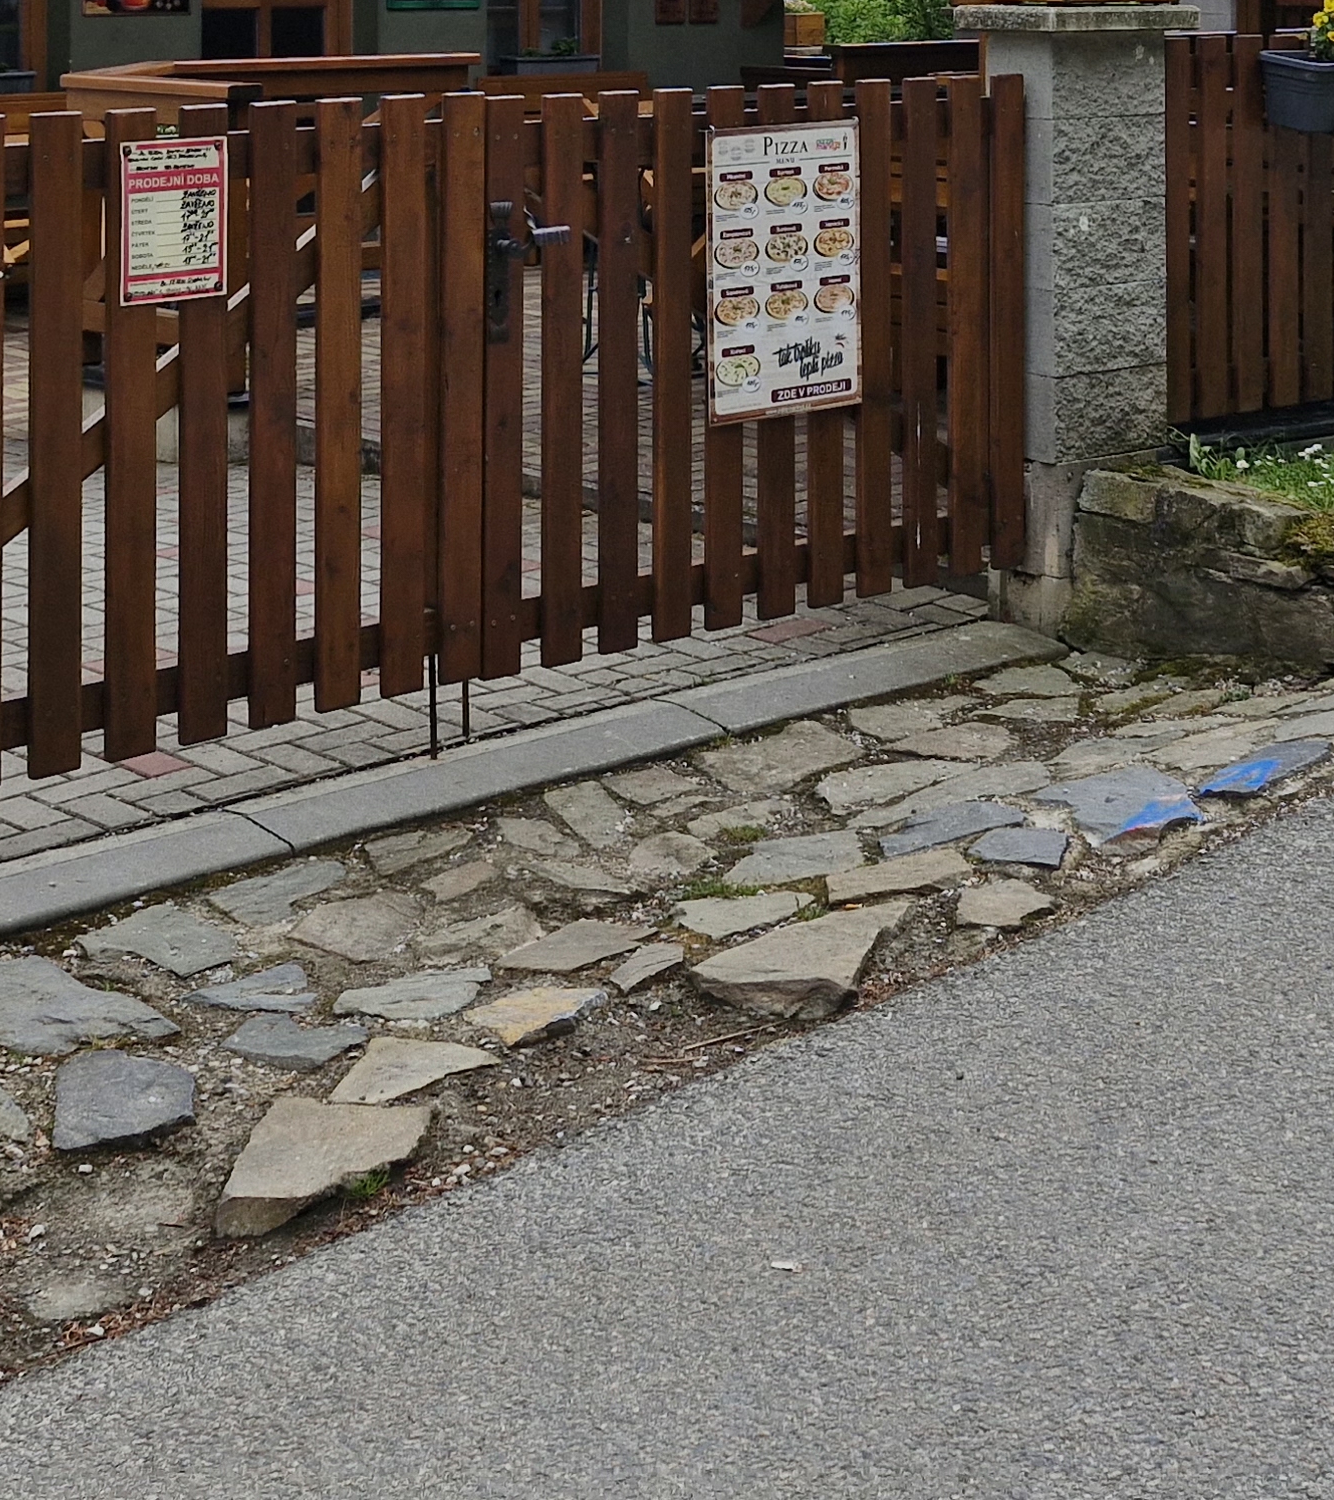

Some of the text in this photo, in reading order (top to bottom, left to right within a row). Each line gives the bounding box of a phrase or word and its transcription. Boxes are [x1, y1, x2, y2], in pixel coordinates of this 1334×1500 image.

[763, 136, 809, 156] PIZZA
[128, 173, 220, 189] PRODEJNÍ DOBA
[772, 343, 793, 367] tak
[799, 350, 844, 381] lepší pizza
[777, 380, 846, 401] ZDE V PRODEJI
